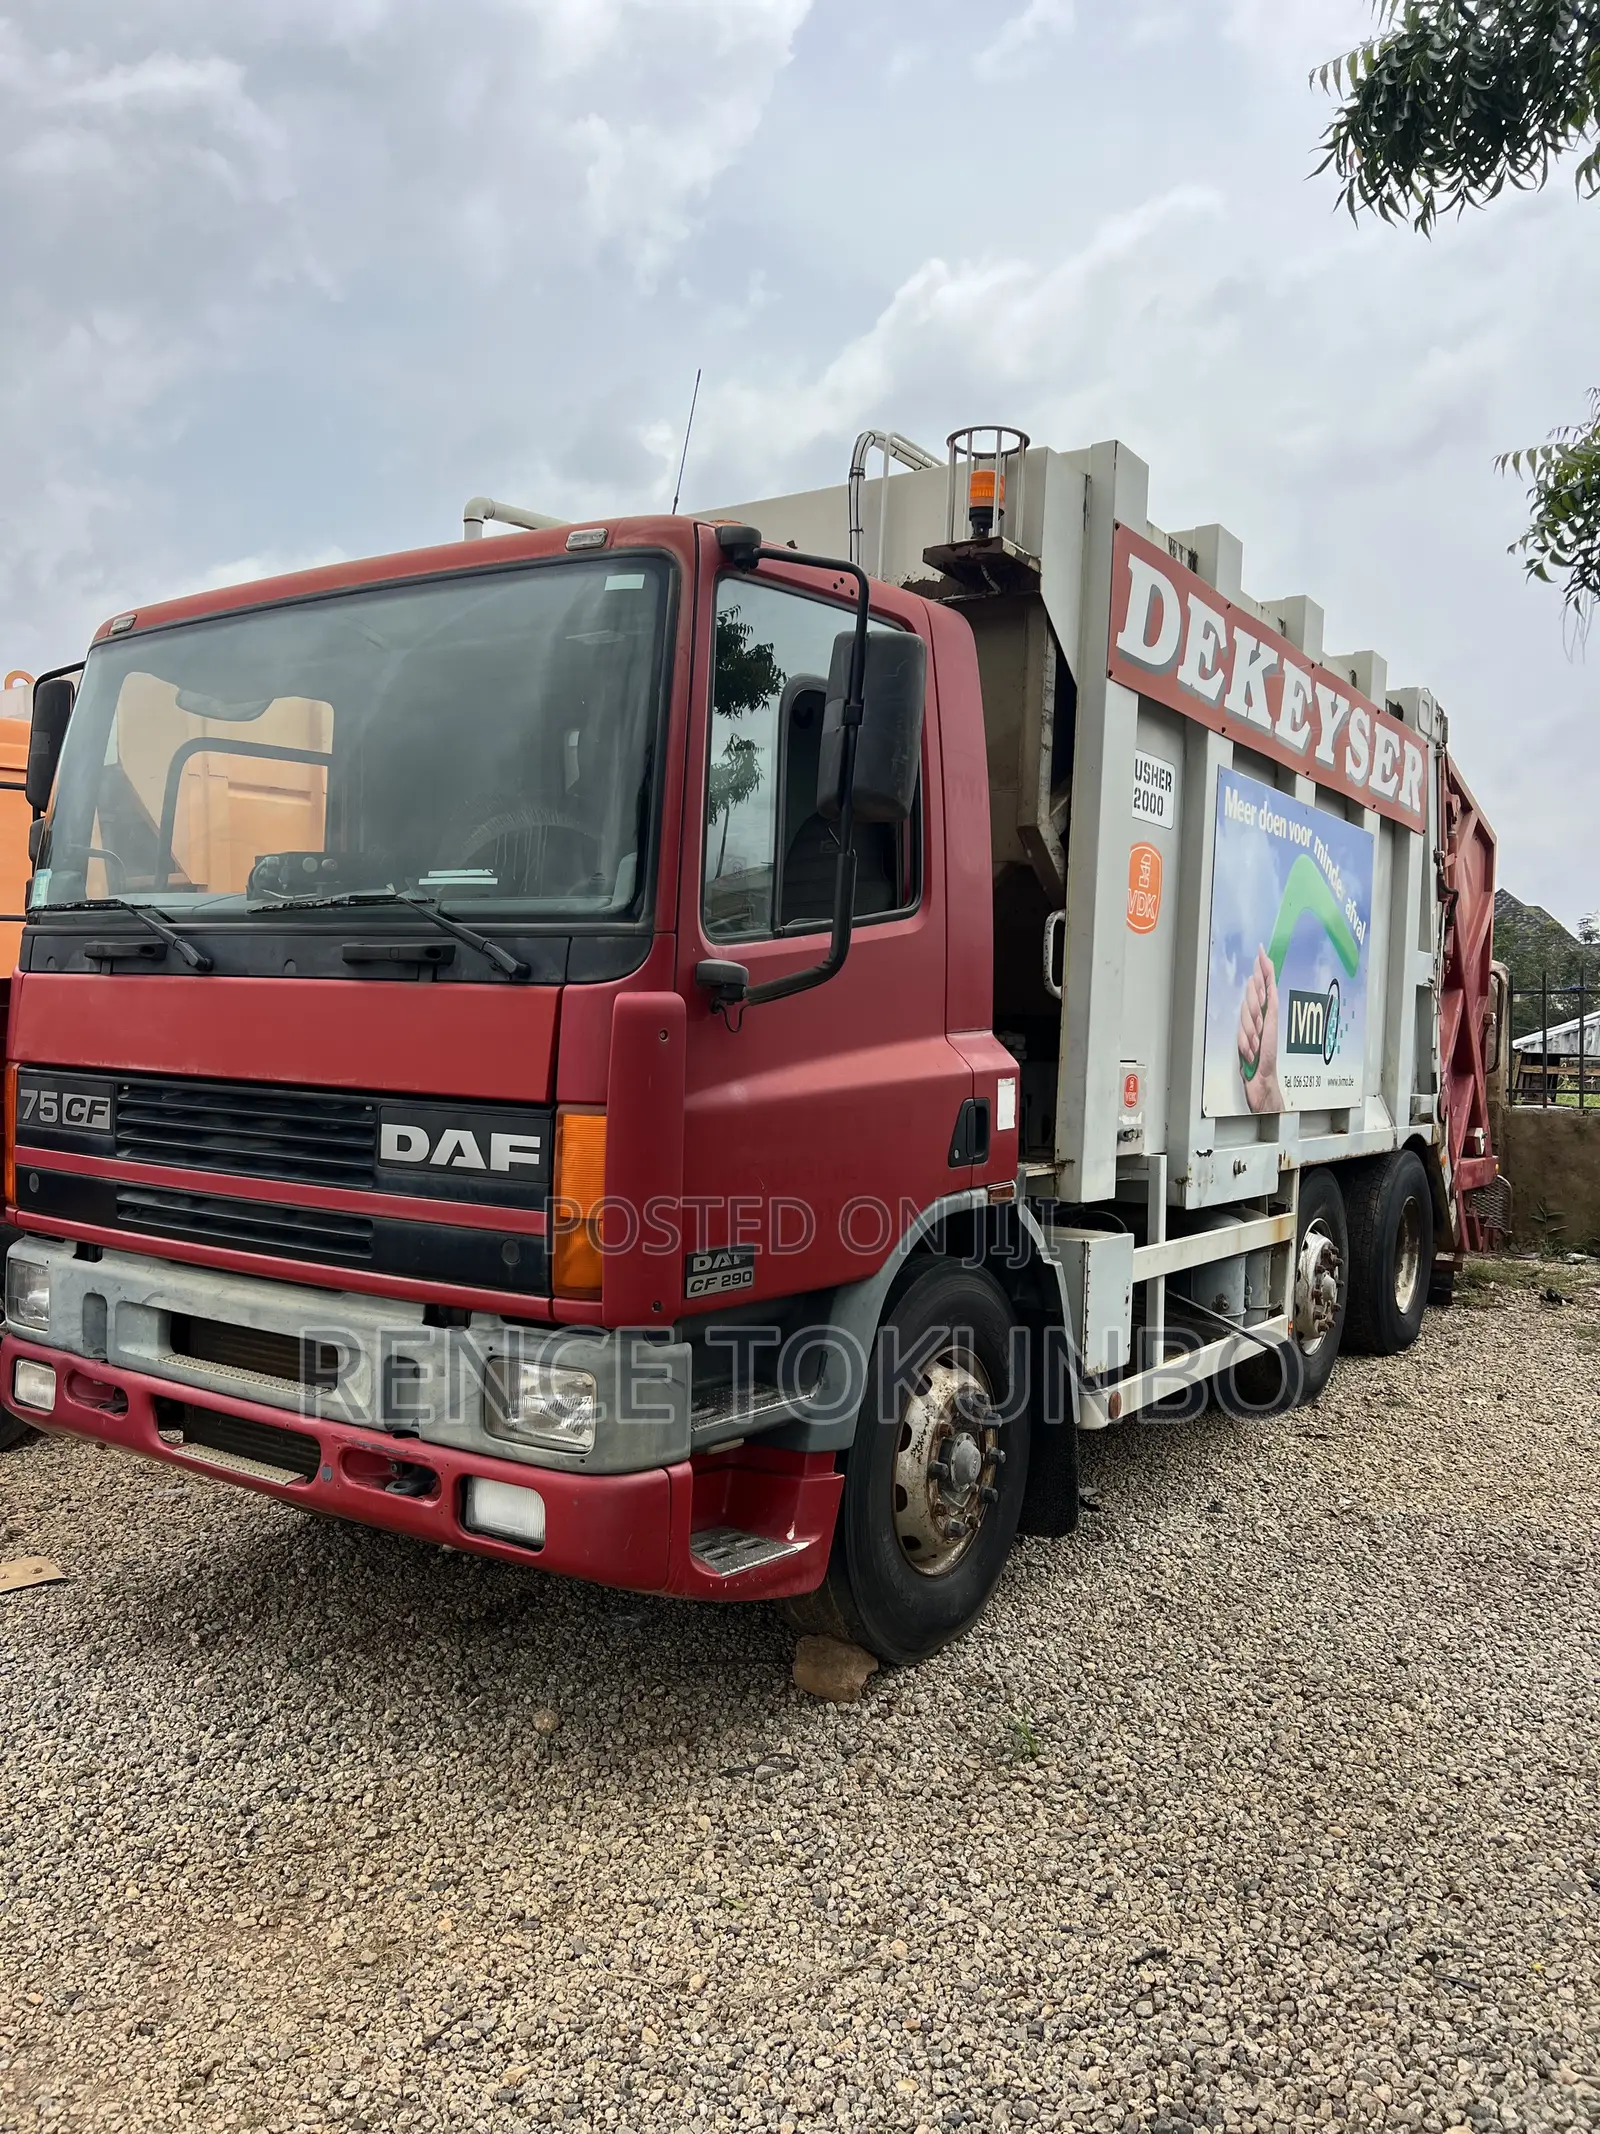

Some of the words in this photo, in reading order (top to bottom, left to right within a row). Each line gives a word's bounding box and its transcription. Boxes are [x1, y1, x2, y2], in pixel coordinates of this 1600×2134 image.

[1116, 553, 1422, 813] DEKEYSER
[1133, 787, 1164, 817] 2000
[1224, 786, 1257, 826] Meer
[1258, 801, 1287, 839] doen
[1289, 820, 1313, 848] voor
[1345, 898, 1367, 945] afval
[1127, 887, 1157, 920] VDK
[1293, 1075, 1302, 1088] 056
[20, 1089, 58, 1123] 75
[65, 1097, 109, 1124] CF
[379, 1123, 541, 1172] DAF
[692, 1250, 750, 1273] DAF
[690, 1276, 718, 1293] CF
[721, 1270, 752, 1288] 290
